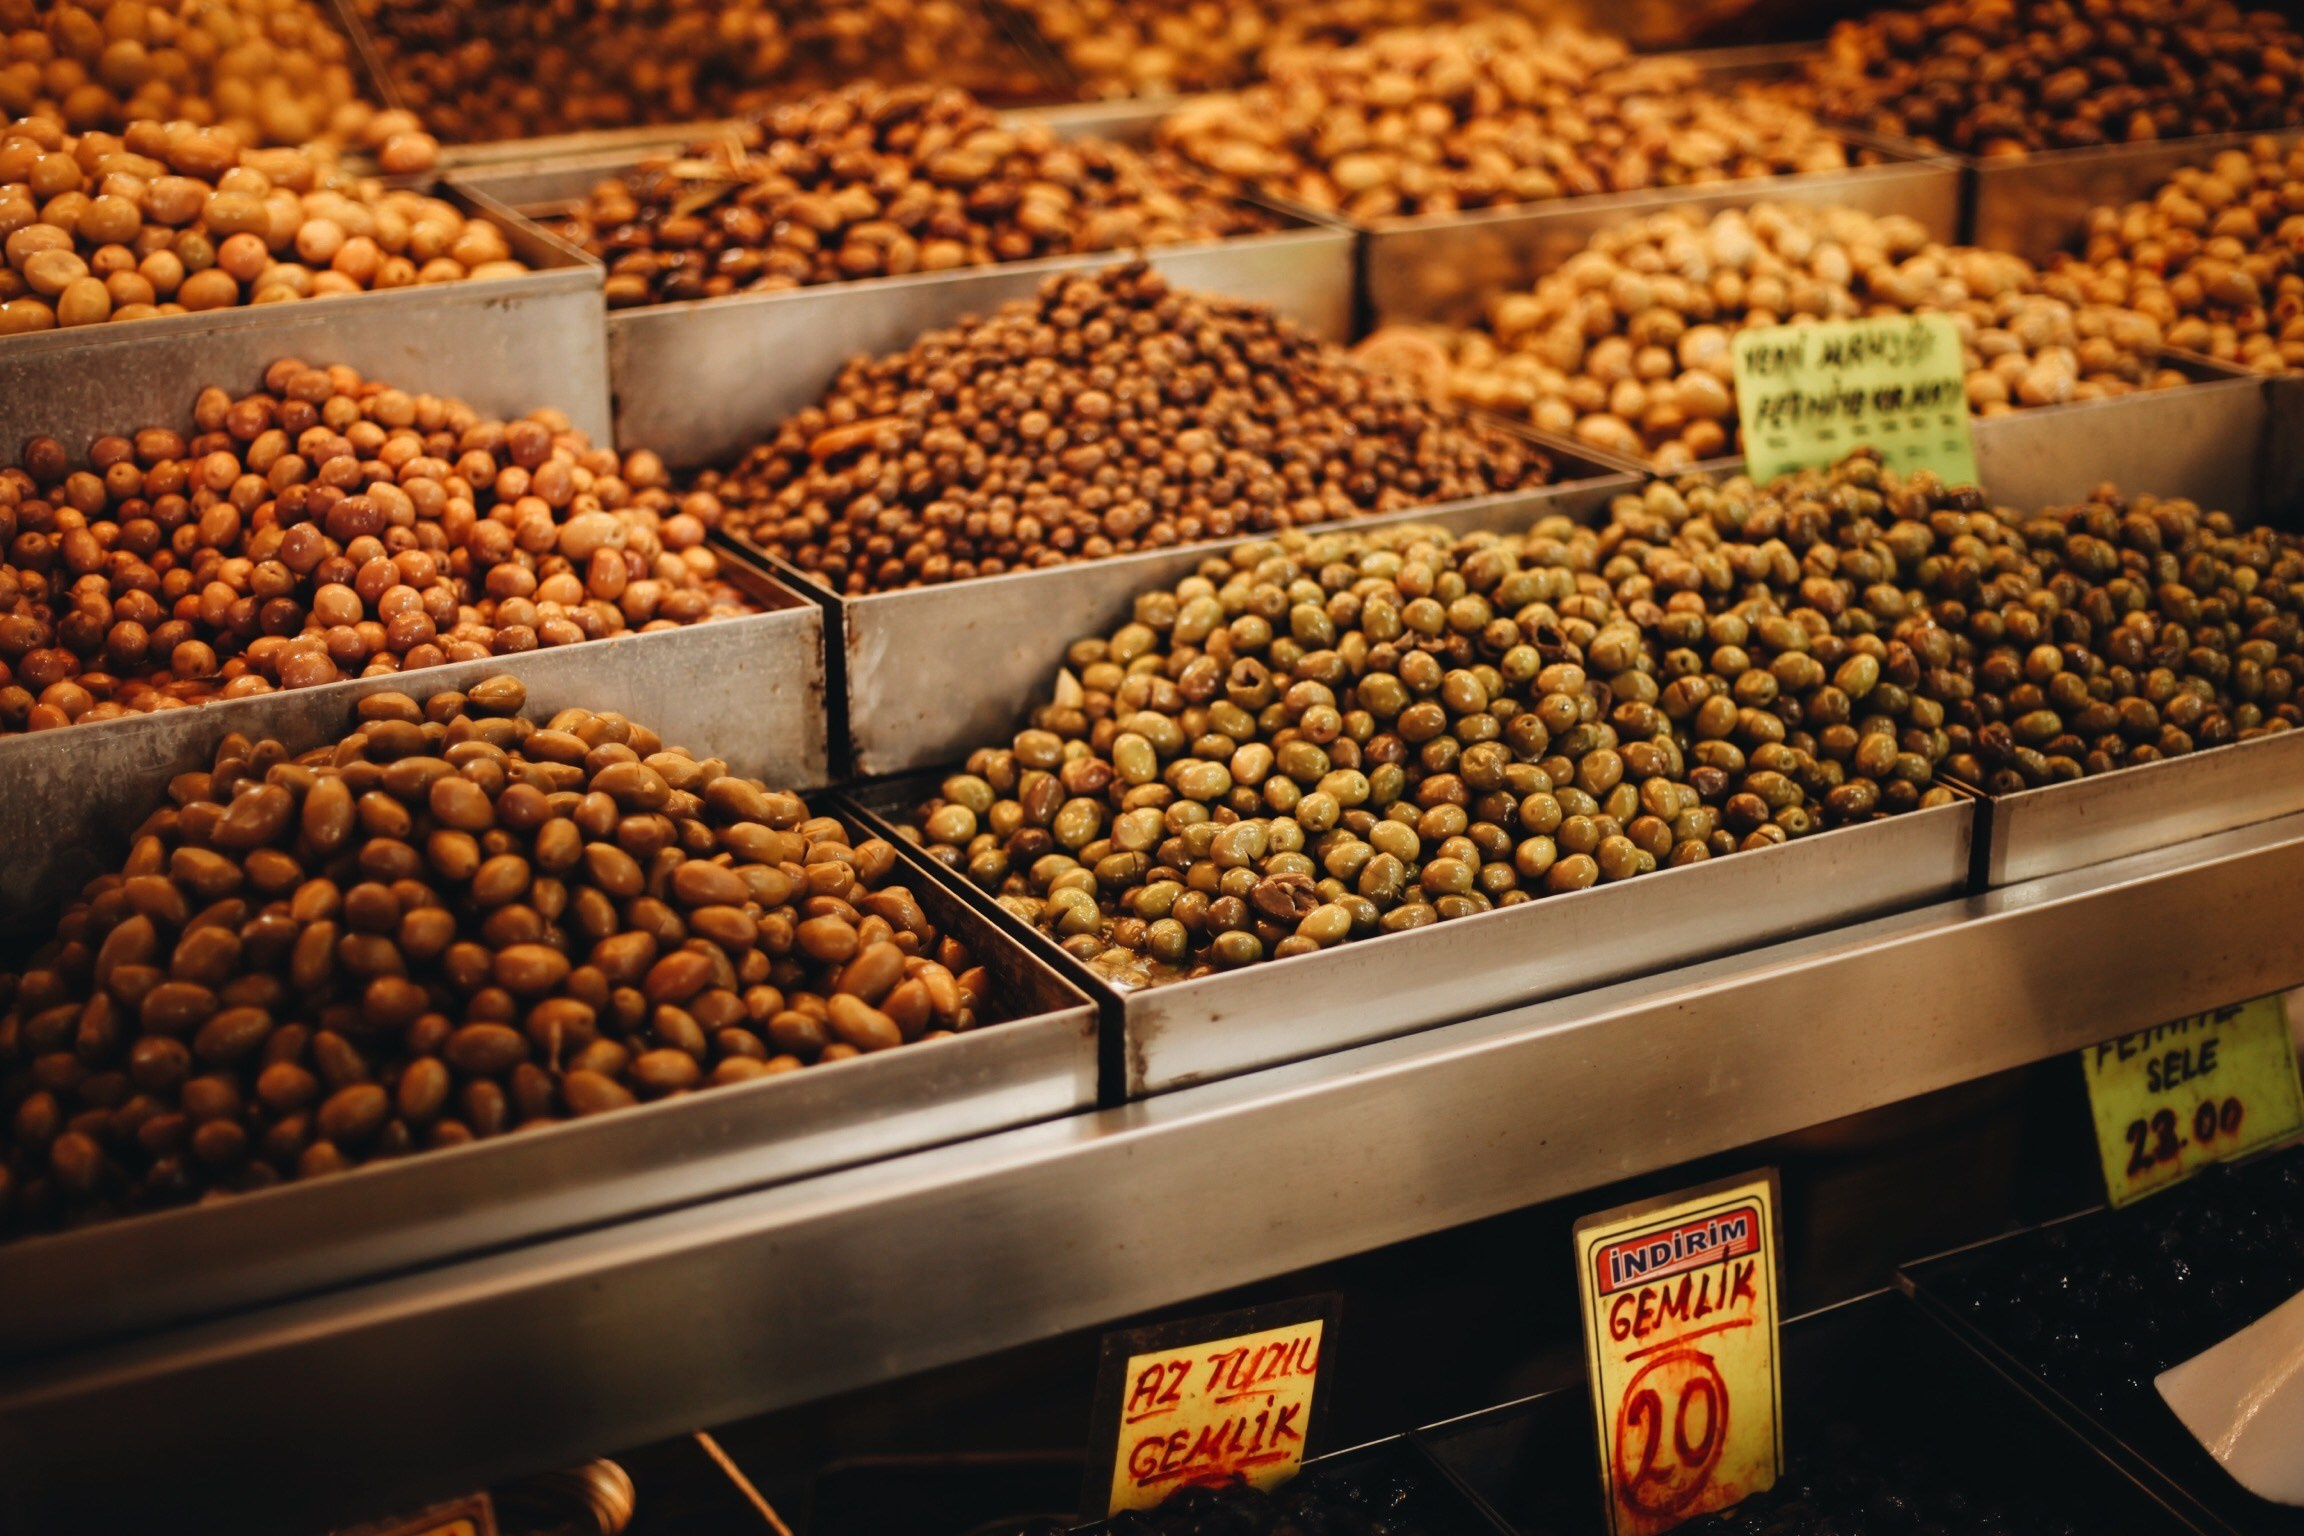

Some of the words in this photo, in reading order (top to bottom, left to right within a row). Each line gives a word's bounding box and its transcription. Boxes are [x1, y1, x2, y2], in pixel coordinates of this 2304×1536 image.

[2146, 1037, 2220, 1093] SELE
[1609, 1216, 1748, 1285] İNDİRİM
[1609, 1245, 1757, 1342] GEMLİK
[1127, 1360, 1193, 1412] AZ
[1128, 1395, 1302, 1479] GEMLİK
[1627, 1376, 1718, 1492] 20
